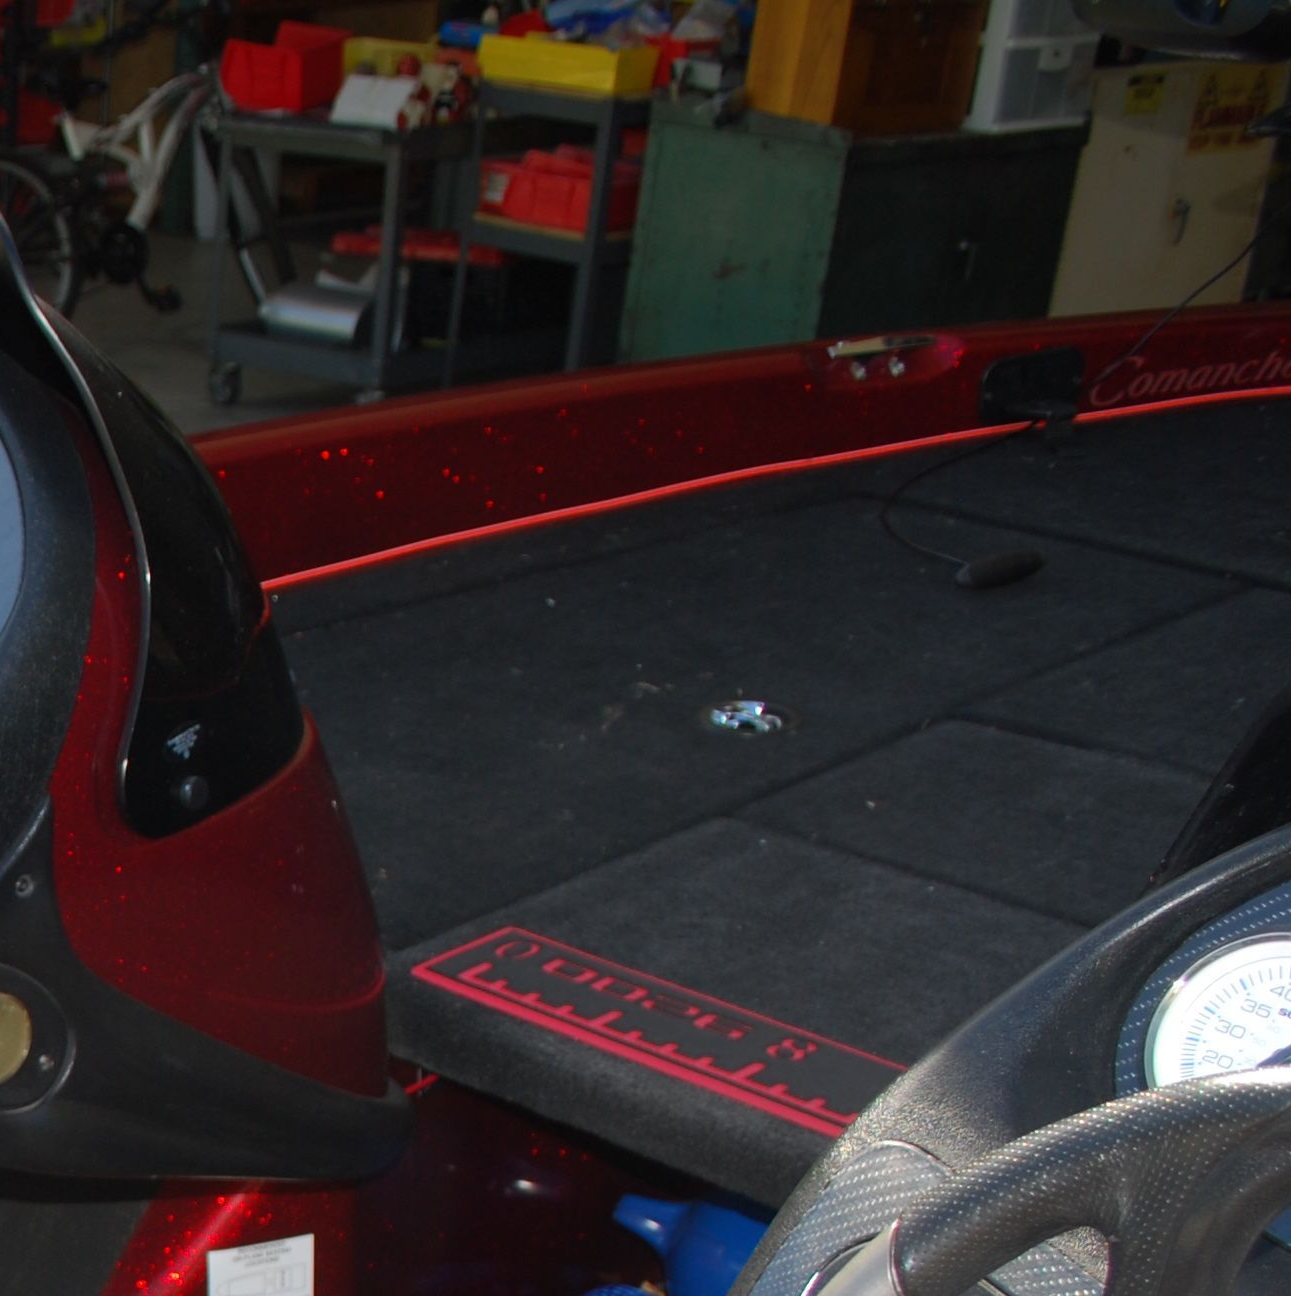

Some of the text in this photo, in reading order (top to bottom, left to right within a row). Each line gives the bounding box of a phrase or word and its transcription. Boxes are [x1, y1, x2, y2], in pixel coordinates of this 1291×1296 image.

[1240, 998, 1274, 1019] 35
[1214, 1019, 1246, 1040] 30
[1202, 1049, 1233, 1070] 20
